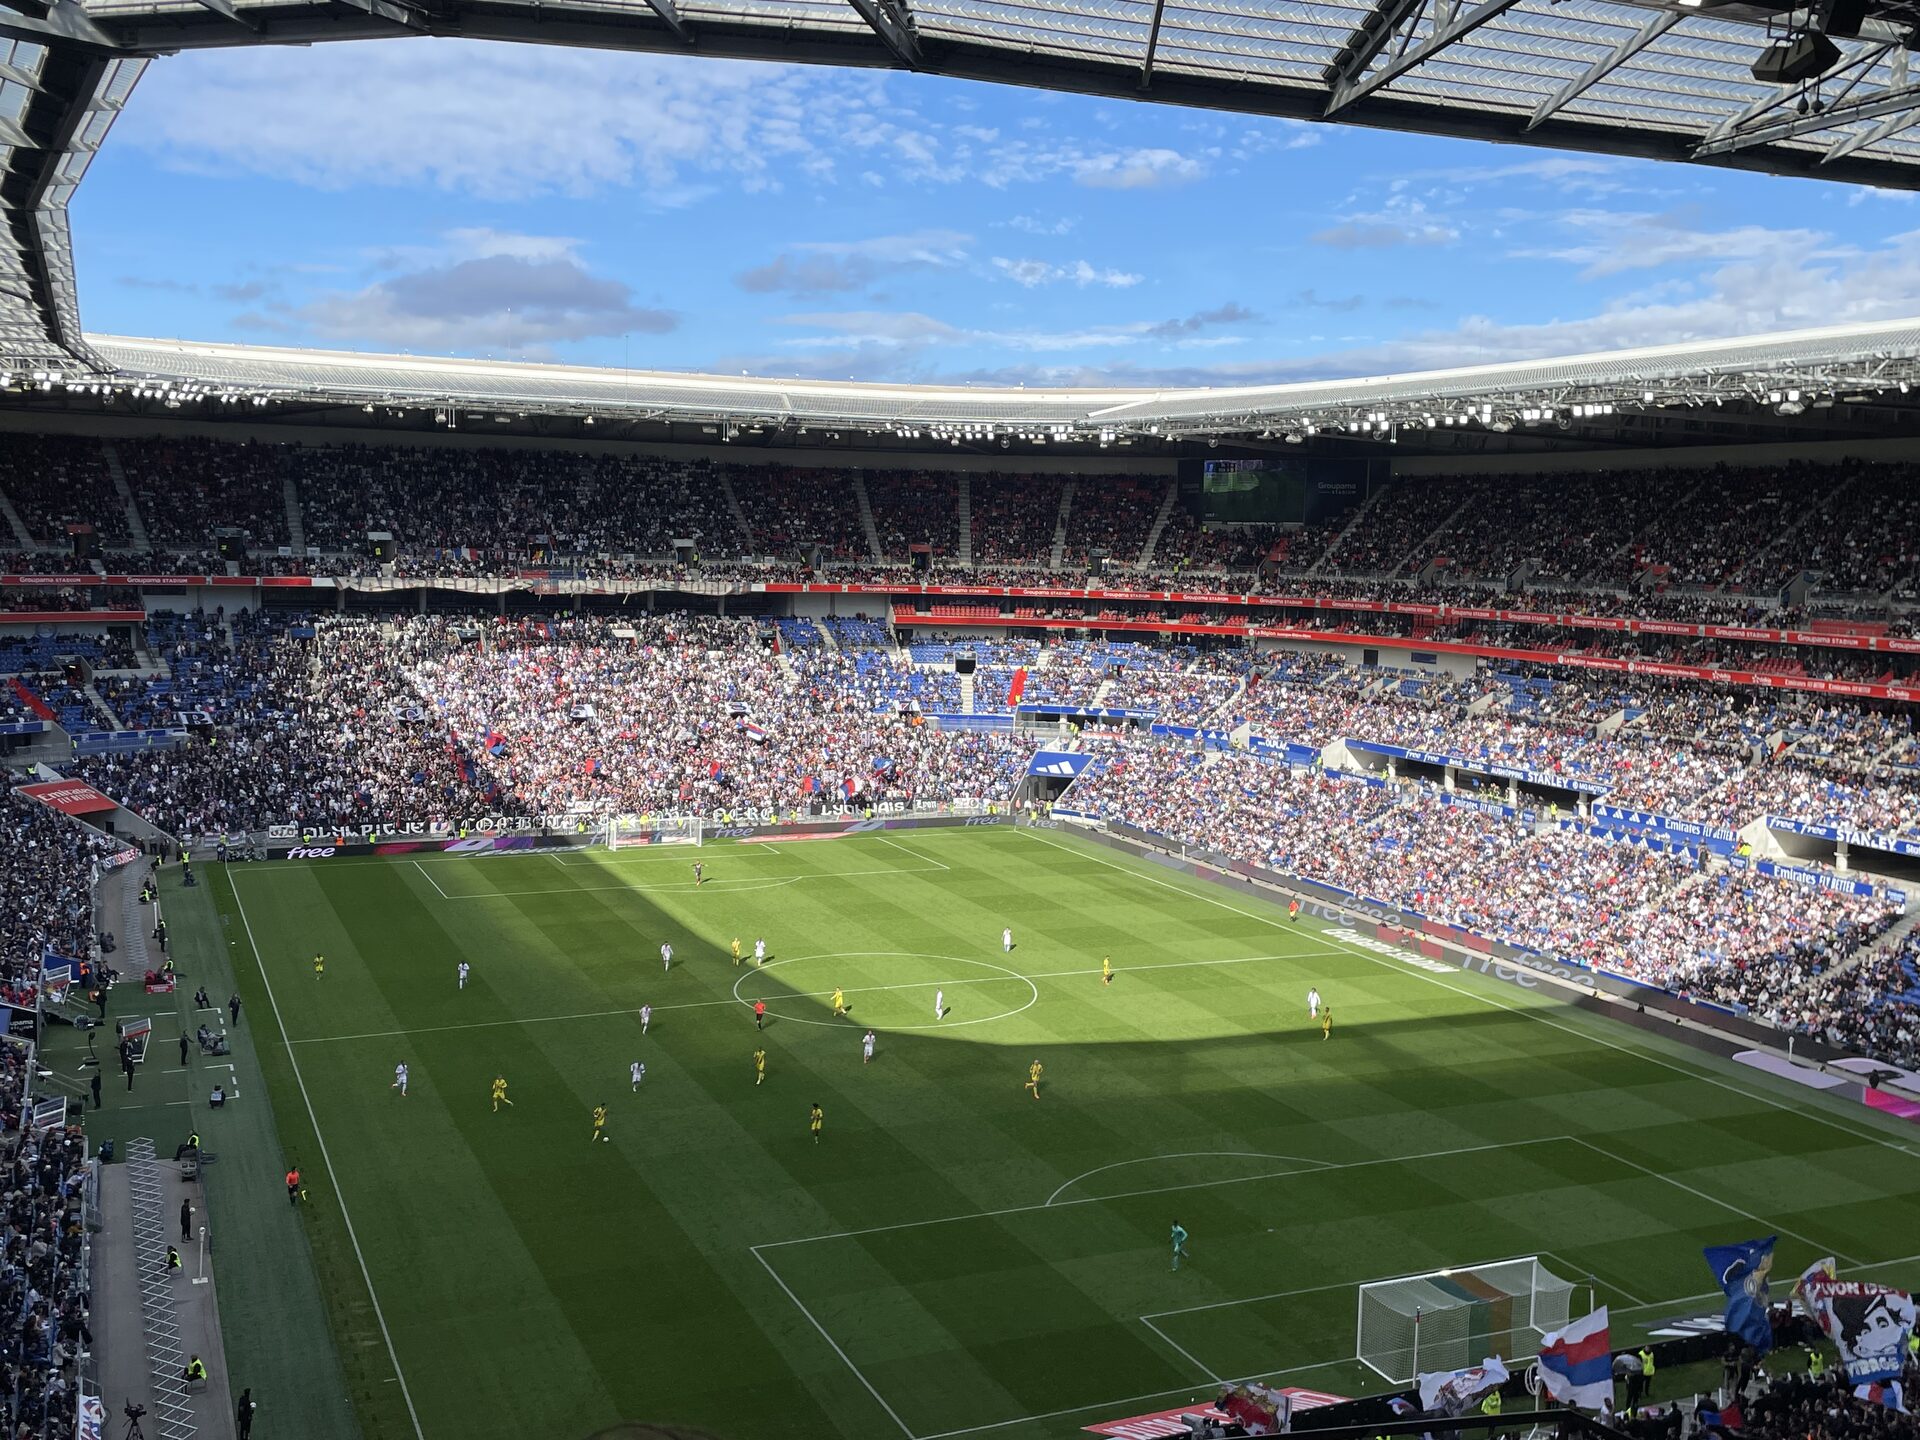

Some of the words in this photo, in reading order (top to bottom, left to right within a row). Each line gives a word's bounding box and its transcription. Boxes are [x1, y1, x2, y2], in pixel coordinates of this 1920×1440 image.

[1317, 481, 1357, 491] Groupama
[19, 576, 54, 584] Groupama
[127, 576, 161, 584] Groupama
[558, 579, 600, 594] KOP
[1102, 591, 1130, 599] Groupama
[1259, 597, 1284, 605] Groupama
[1397, 605, 1417, 613] Groupama
[1451, 609, 1472, 617] Groupama
[1508, 613, 1532, 621] Groupama
[1571, 617, 1596, 626] Groupama
[1639, 622, 1667, 632] Groupama
[1715, 627, 1746, 638] Groupama
[1797, 633, 1830, 645] Groupama
[1888, 640, 1920, 651] Groupam
[1406, 749, 1421, 759] free
[1424, 750, 1440, 762] free
[1528, 771, 1568, 789] STANLEY
[36, 788, 96, 802] Emirates
[1450, 795, 1479, 810] Emirates
[964, 815, 999, 827] free
[1769, 815, 1795, 829] free
[715, 827, 753, 838] free
[1665, 818, 1701, 835] Emirates
[1702, 825, 1712, 836] FLY
[1800, 823, 1827, 836] free
[286, 846, 335, 860] free
[1773, 865, 1816, 885] Emirates
[1819, 875, 1830, 888] FLY
[1831, 877, 1856, 893] BETTER
